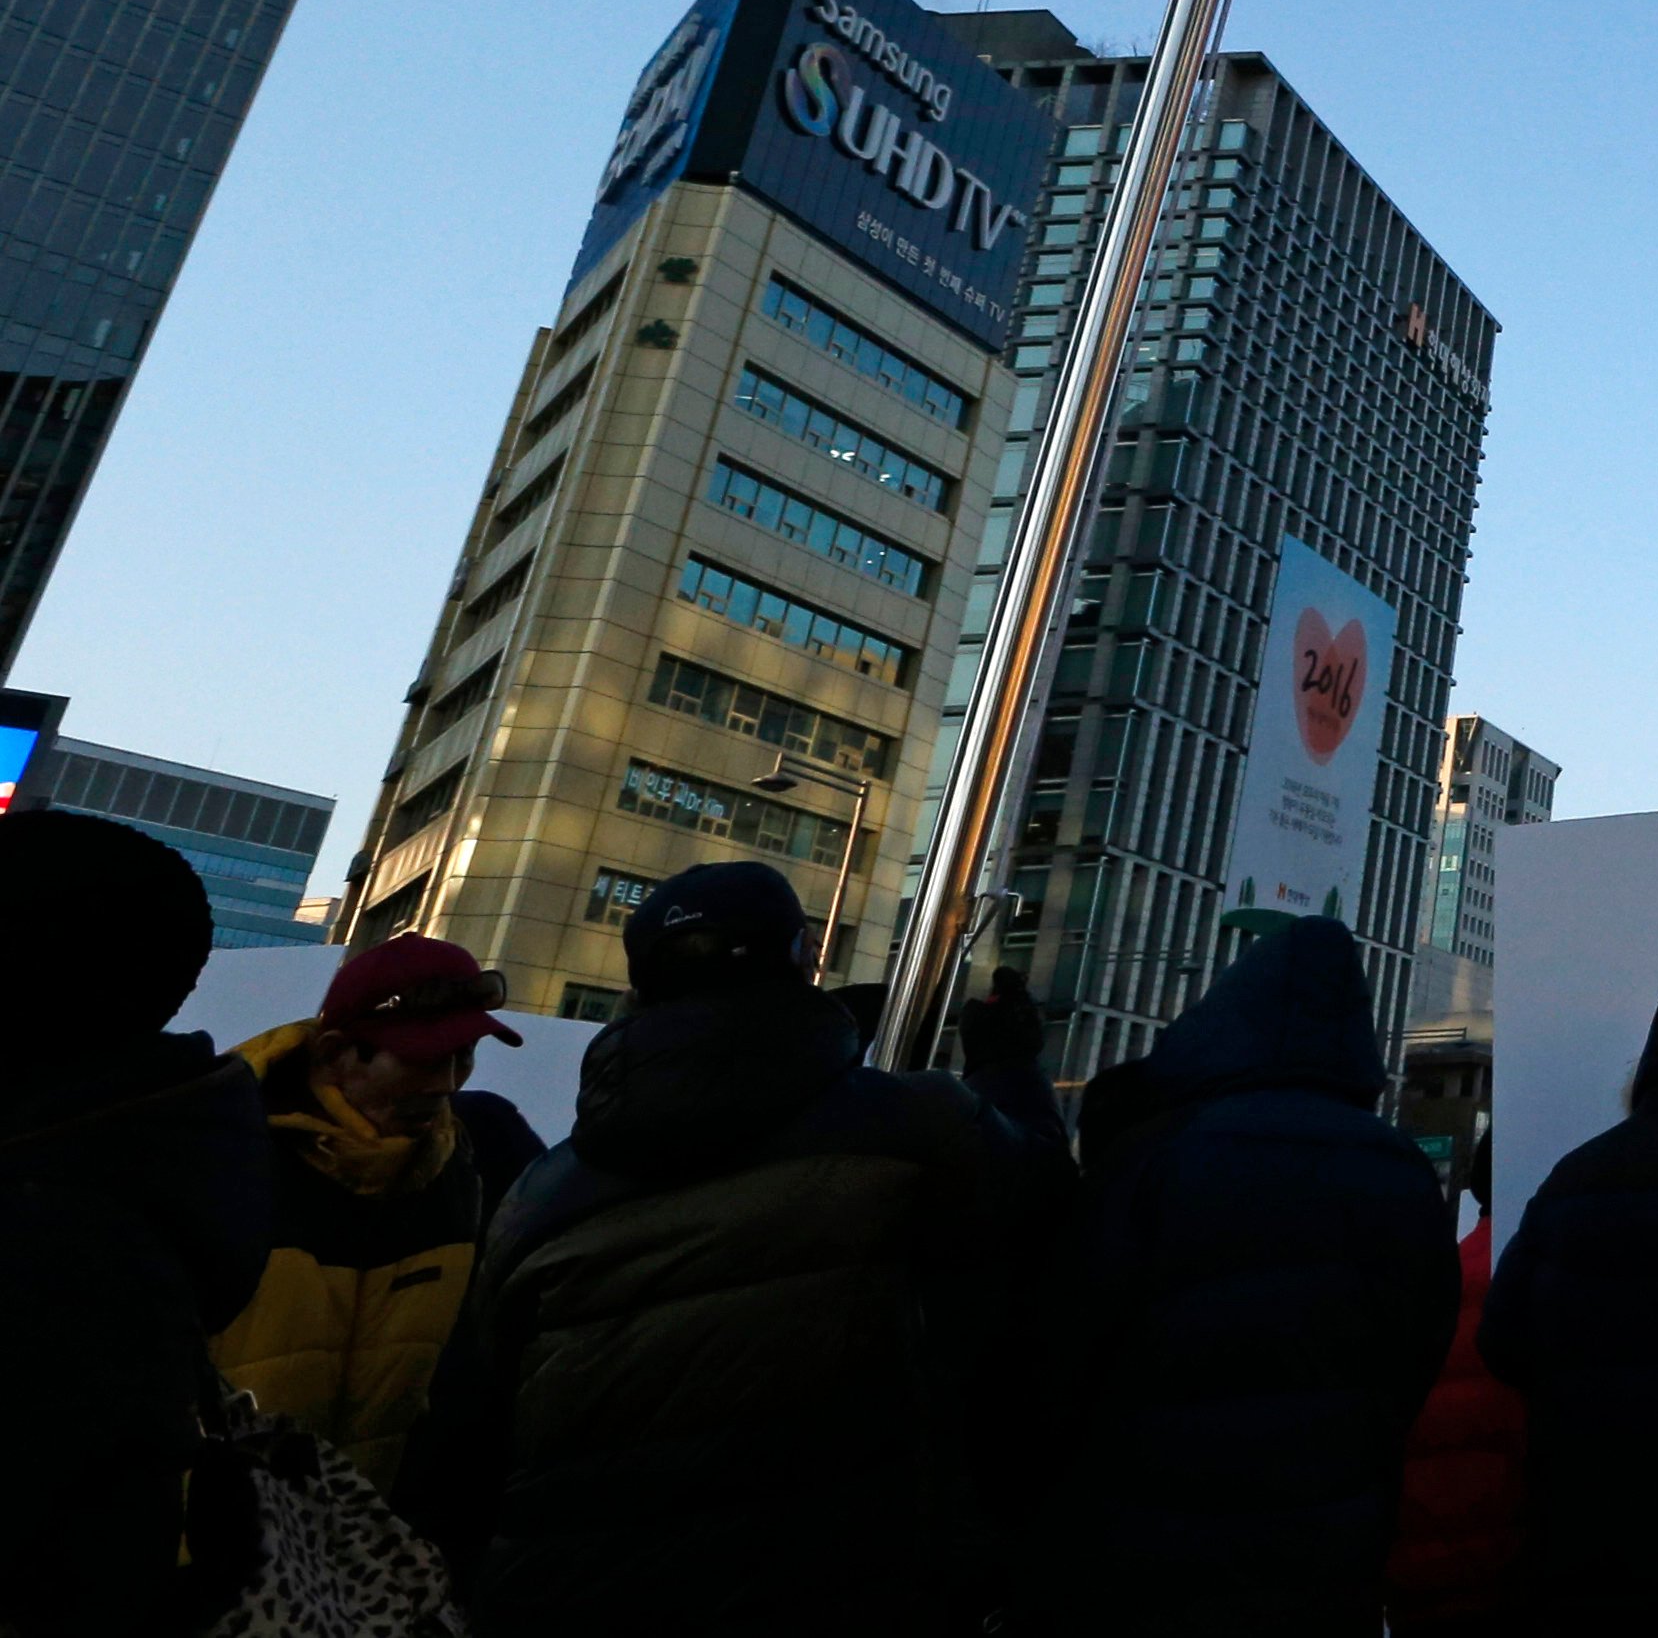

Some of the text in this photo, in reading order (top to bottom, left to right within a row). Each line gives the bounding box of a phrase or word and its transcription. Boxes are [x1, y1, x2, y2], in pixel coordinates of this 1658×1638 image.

[857, 211, 895, 249] 삼성이
[896, 237, 921, 266] 만든
[989, 301, 1006, 323] TV
[1302, 648, 1359, 719] 2016
